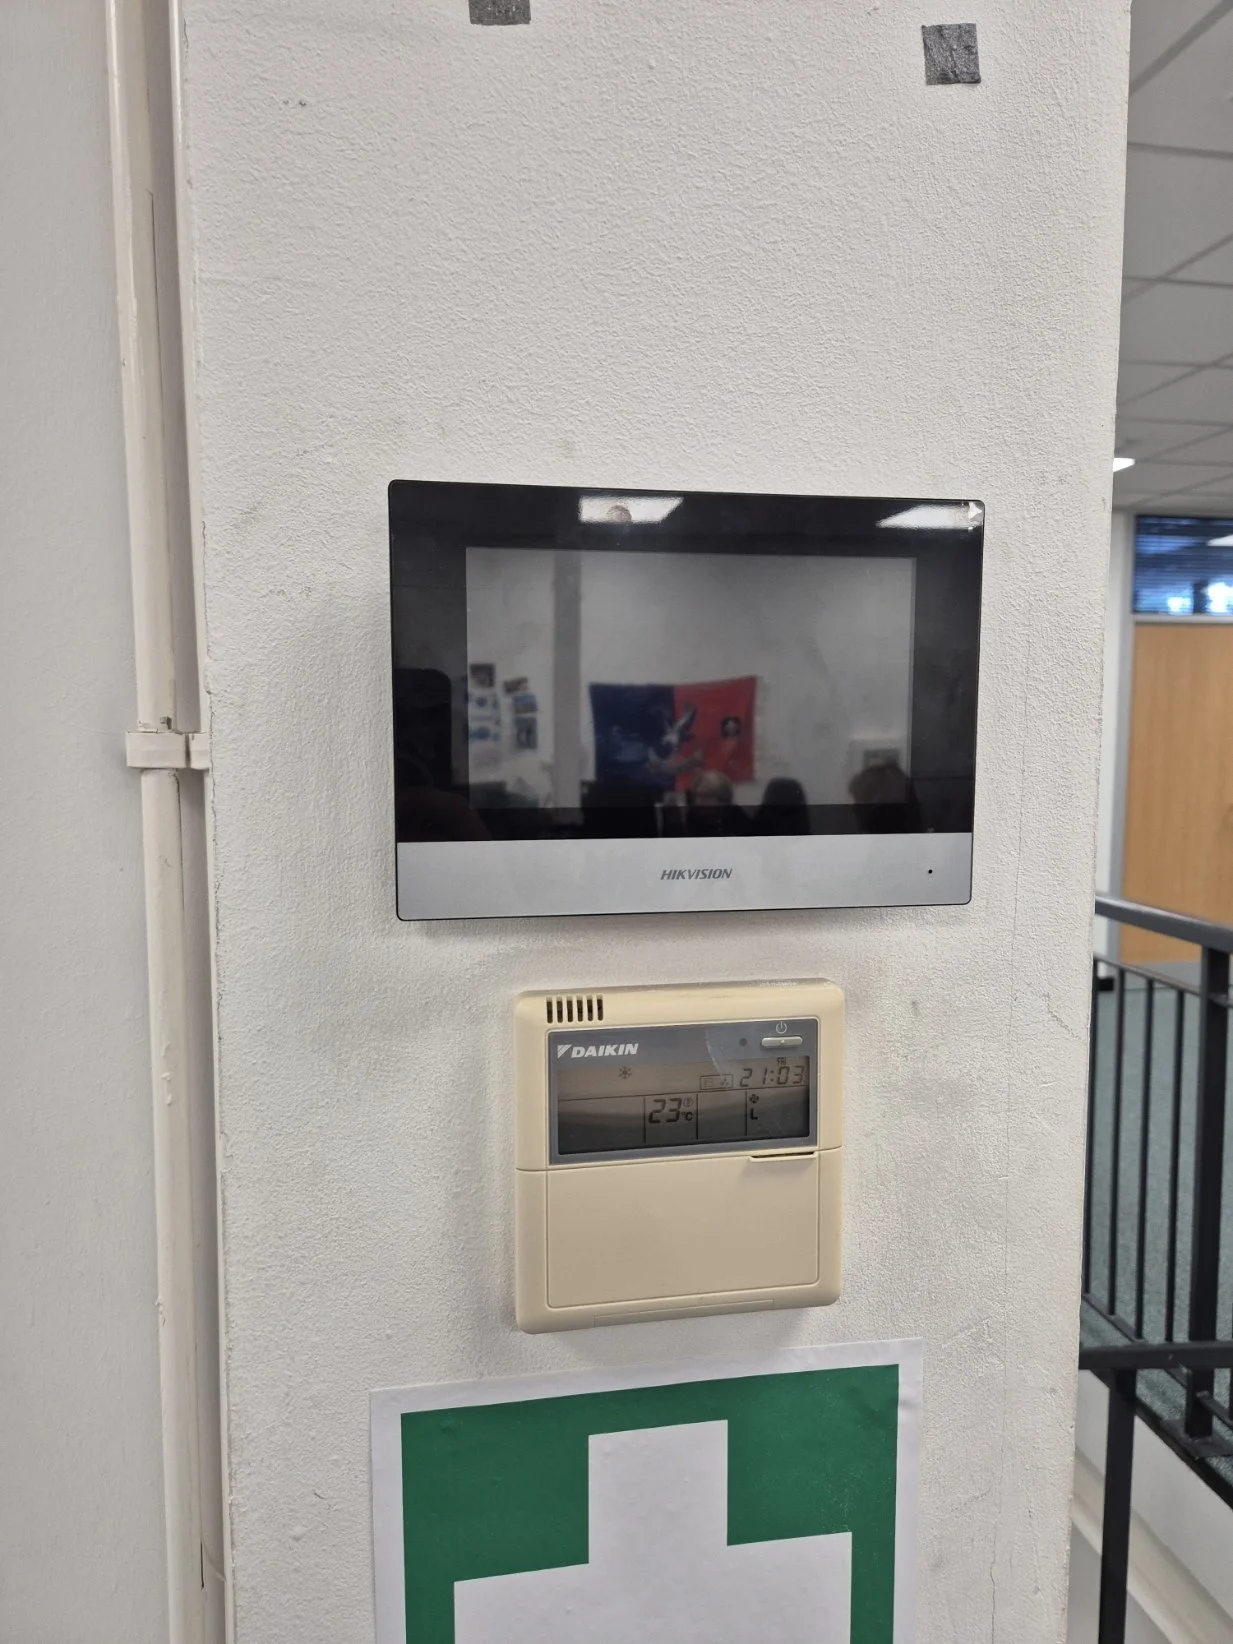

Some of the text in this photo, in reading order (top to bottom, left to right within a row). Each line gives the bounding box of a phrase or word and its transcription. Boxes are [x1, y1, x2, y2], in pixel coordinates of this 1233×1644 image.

[660, 868, 733, 881] HIKVISION
[571, 1043, 639, 1058] DAIKIN
[740, 1065, 805, 1087] 21:03
[750, 1107, 759, 1120] L
